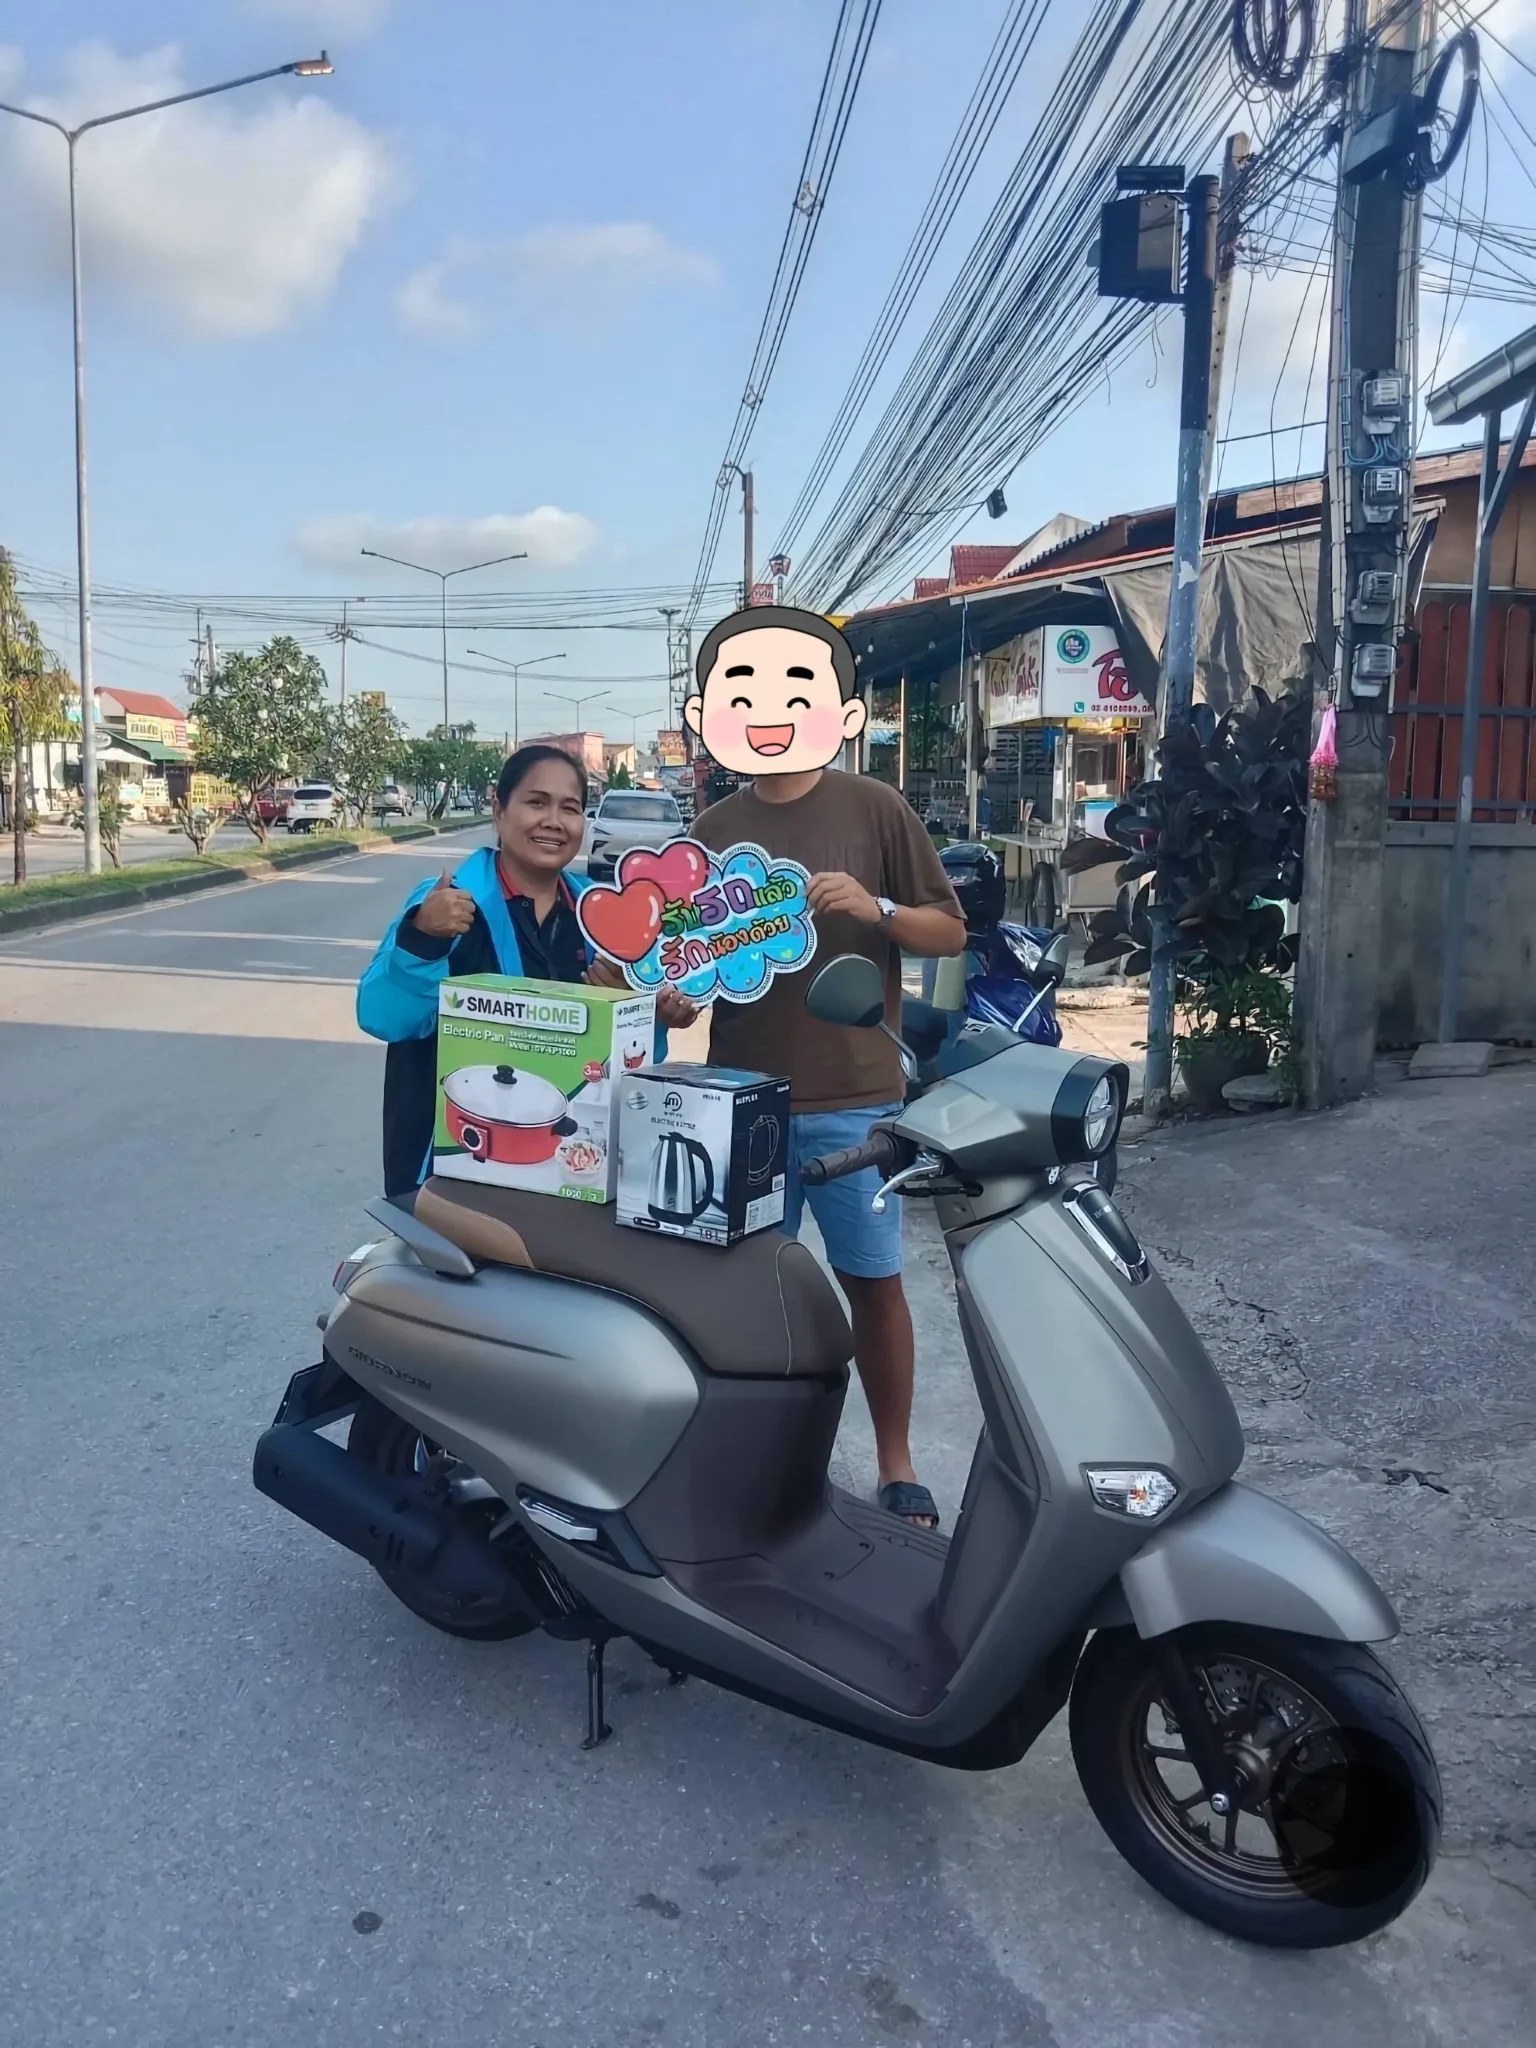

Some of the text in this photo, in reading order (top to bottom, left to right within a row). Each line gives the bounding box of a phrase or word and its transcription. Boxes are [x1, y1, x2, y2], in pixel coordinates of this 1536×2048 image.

[660, 914, 791, 981] รักน้องด้วย
[466, 996, 581, 1026] SMARTHOME
[443, 1023, 482, 1041] Electric
[483, 1029, 505, 1044] Pan
